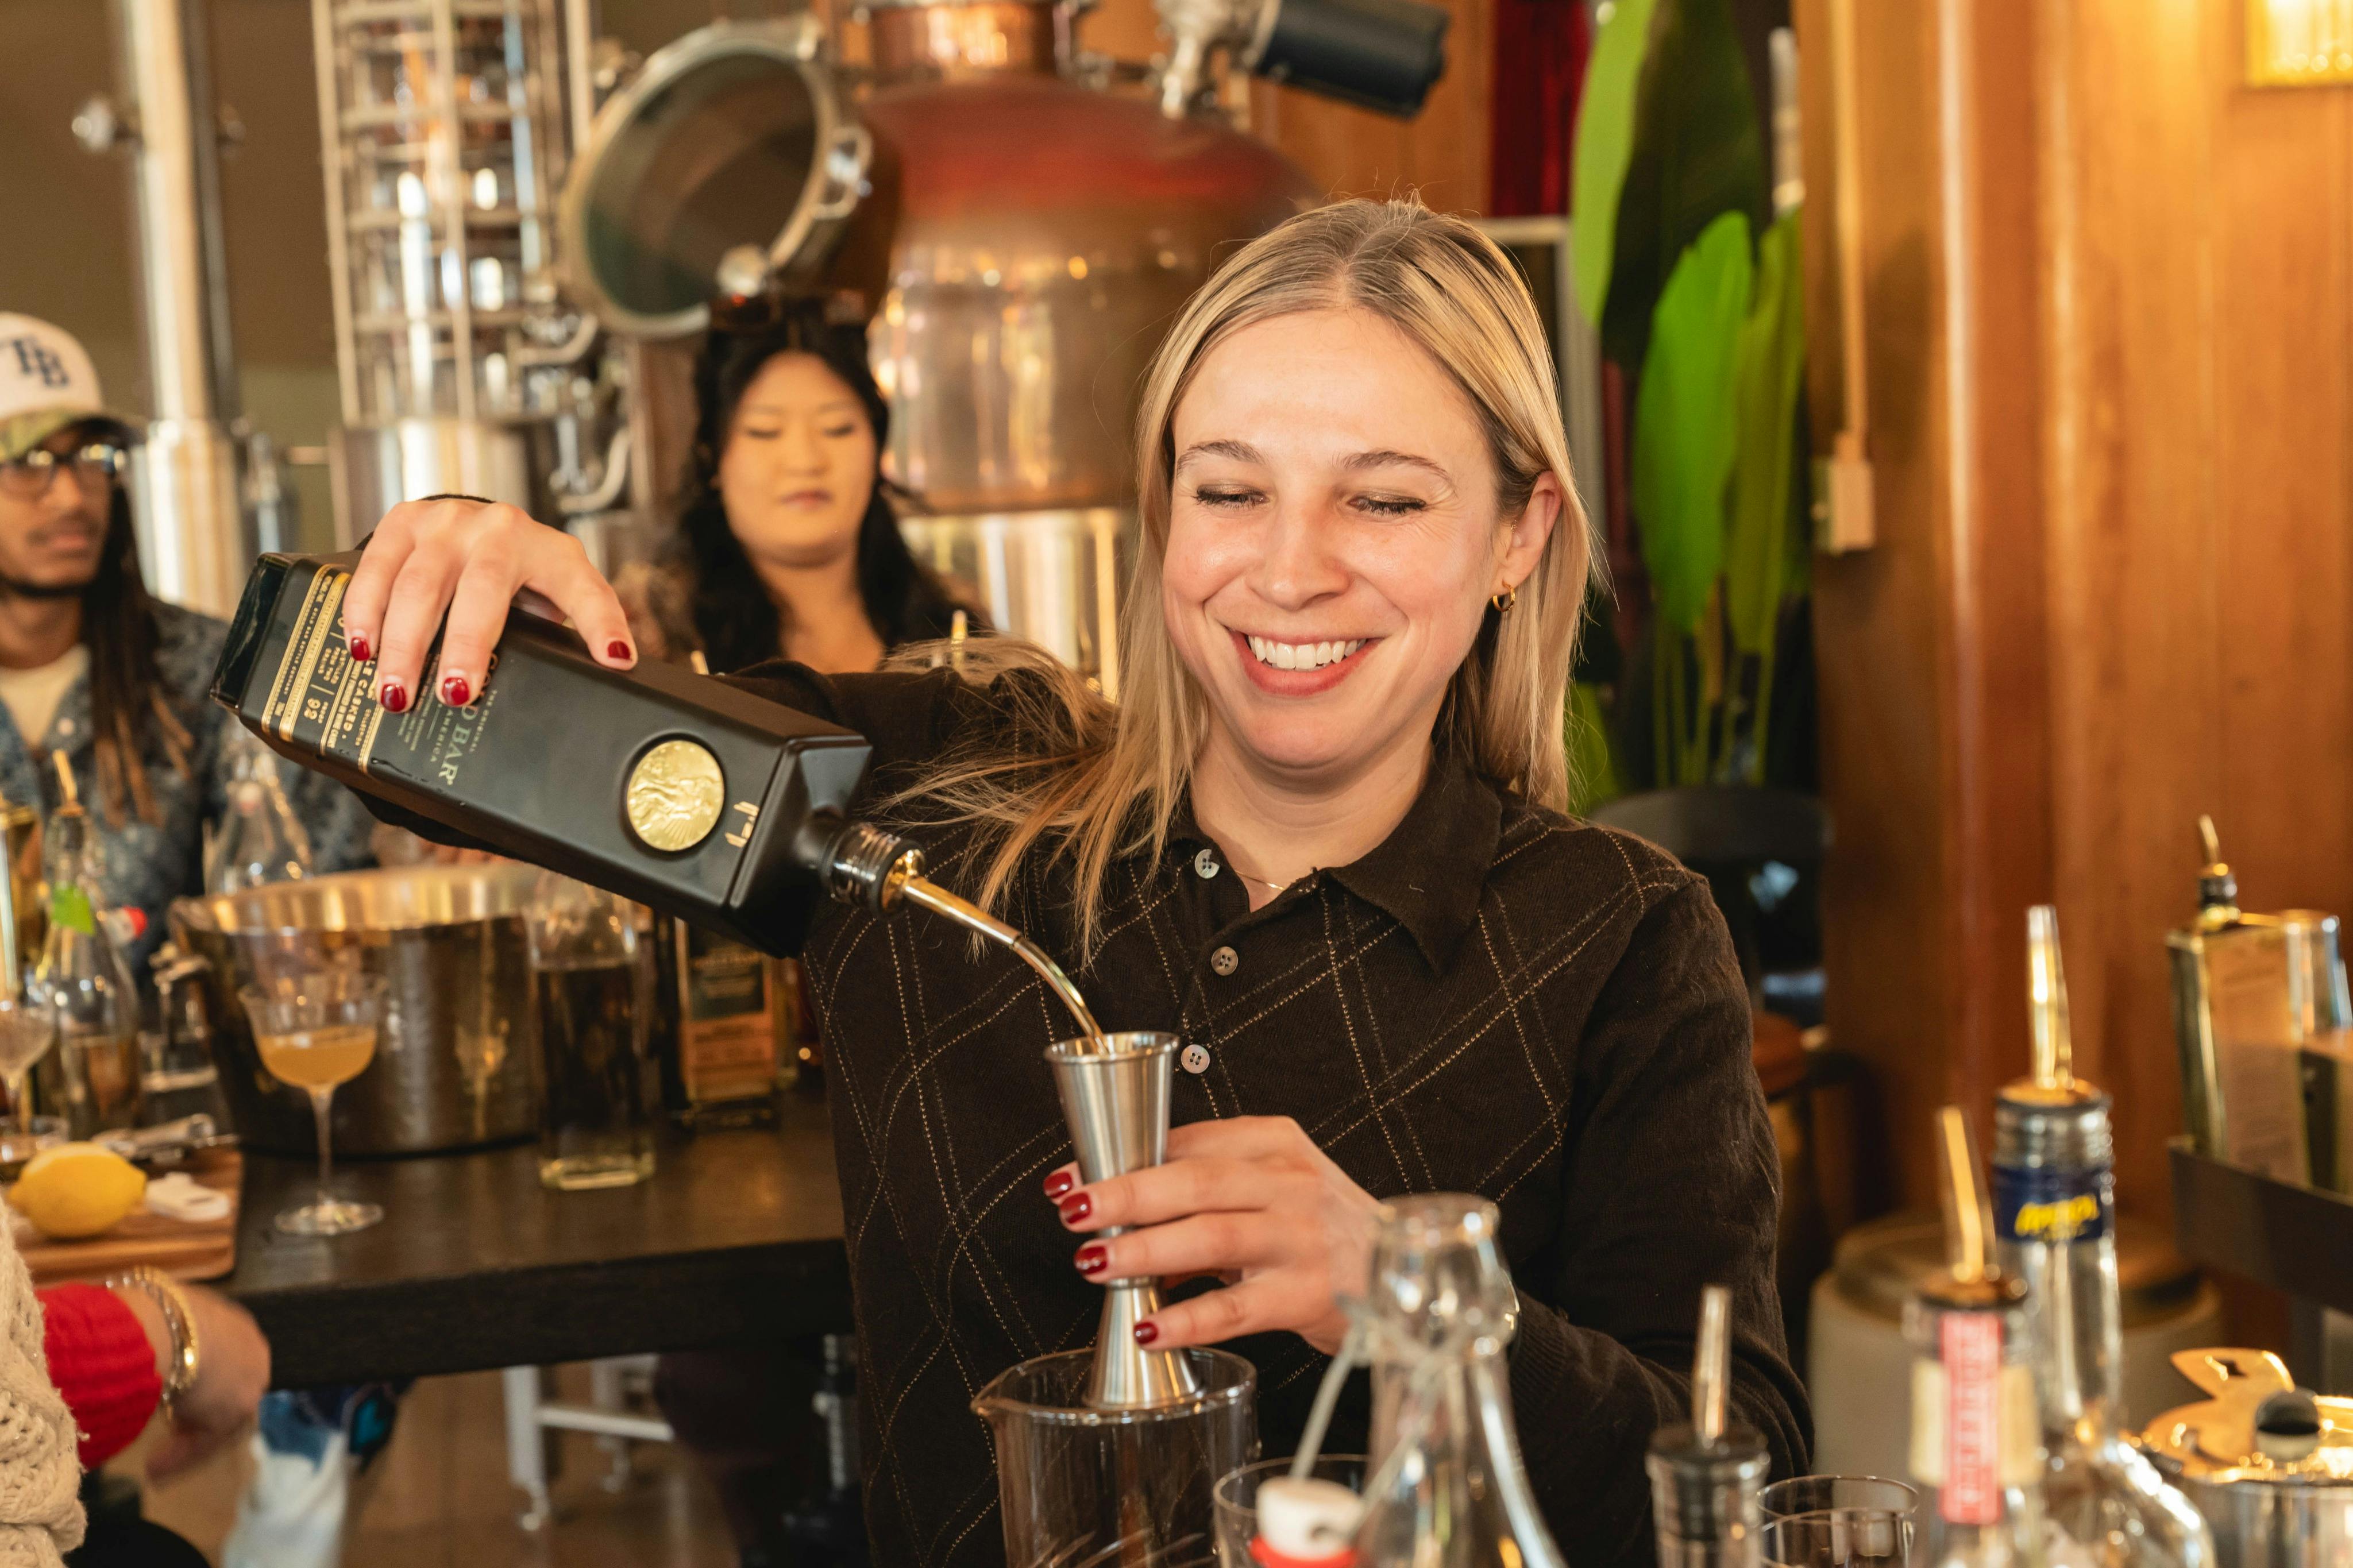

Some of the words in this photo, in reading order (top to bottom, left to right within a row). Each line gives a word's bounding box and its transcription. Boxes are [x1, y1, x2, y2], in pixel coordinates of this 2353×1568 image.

[330, 647, 340, 665] FROM
[330, 650, 349, 683] DISTILLED
[323, 667, 333, 681] TWO
[304, 698, 320, 719] 92
[318, 702, 328, 723] PROOF
[343, 679, 367, 731] CASKED
[430, 710, 453, 762] AMERICA
[469, 710, 488, 752] ORIGINAL
[438, 727, 472, 782] BAR
